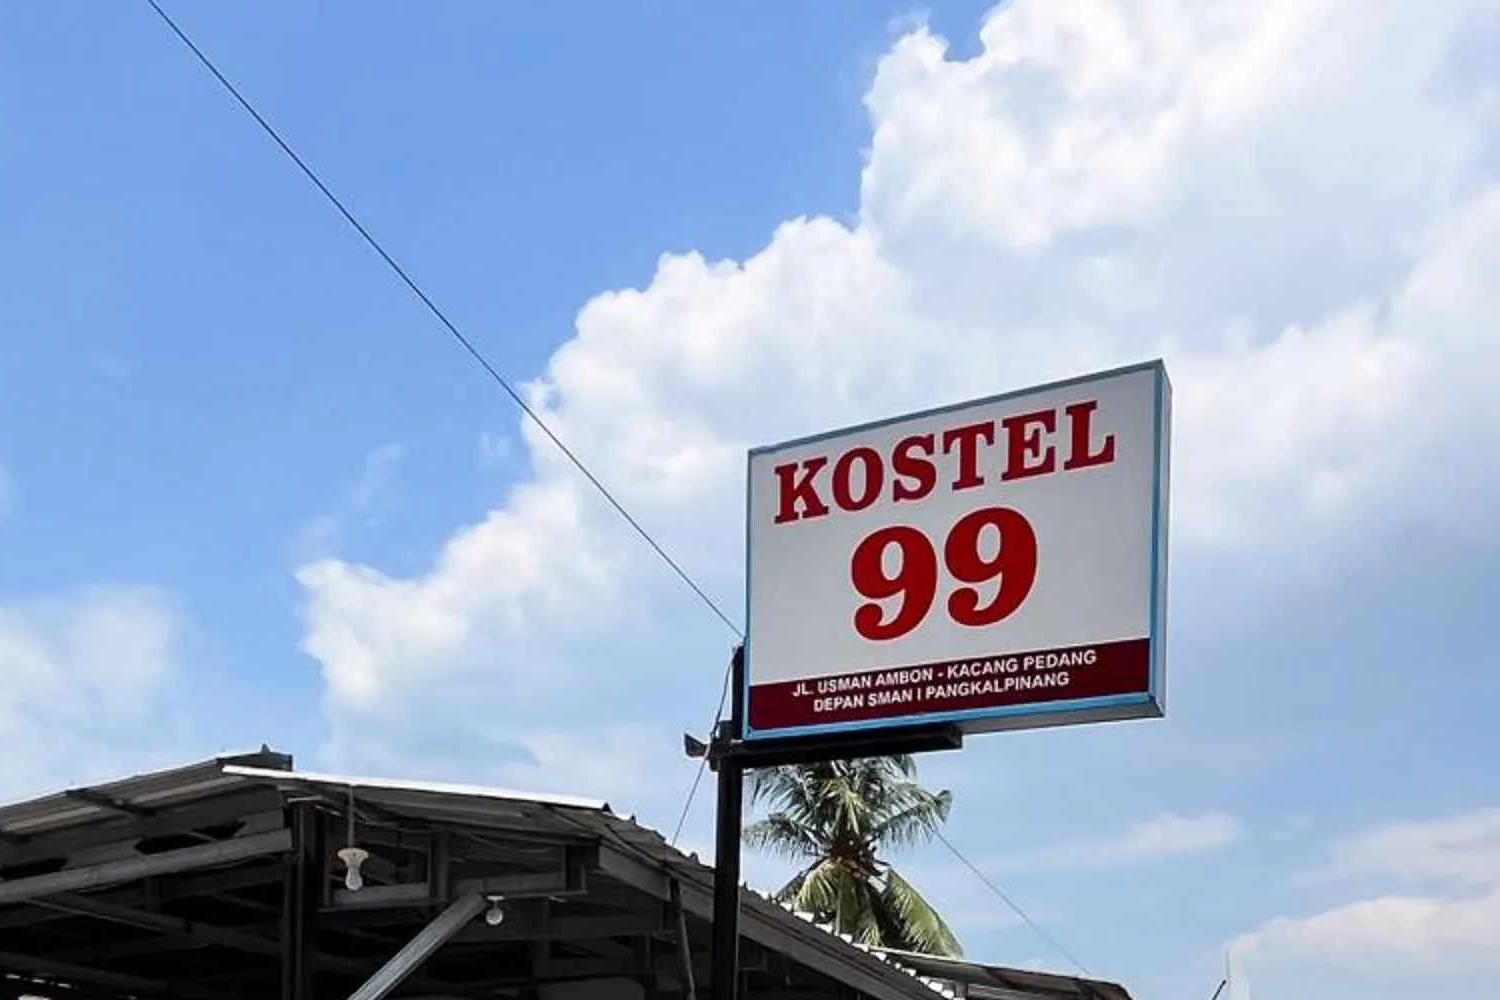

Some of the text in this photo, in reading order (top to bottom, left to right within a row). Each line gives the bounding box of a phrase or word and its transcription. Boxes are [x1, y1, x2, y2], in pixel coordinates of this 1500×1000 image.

[774, 400, 1115, 524] KOSTEL
[851, 507, 1037, 641] 99
[813, 694, 864, 712] DEPAN
[867, 689, 913, 707] SMAN
[925, 671, 1070, 699] PANGKALPINANG
[817, 676, 872, 694] USMAN
[875, 668, 934, 687] AMBON
[947, 658, 1019, 679] KACANG
[1023, 649, 1098, 671] PEDANG
